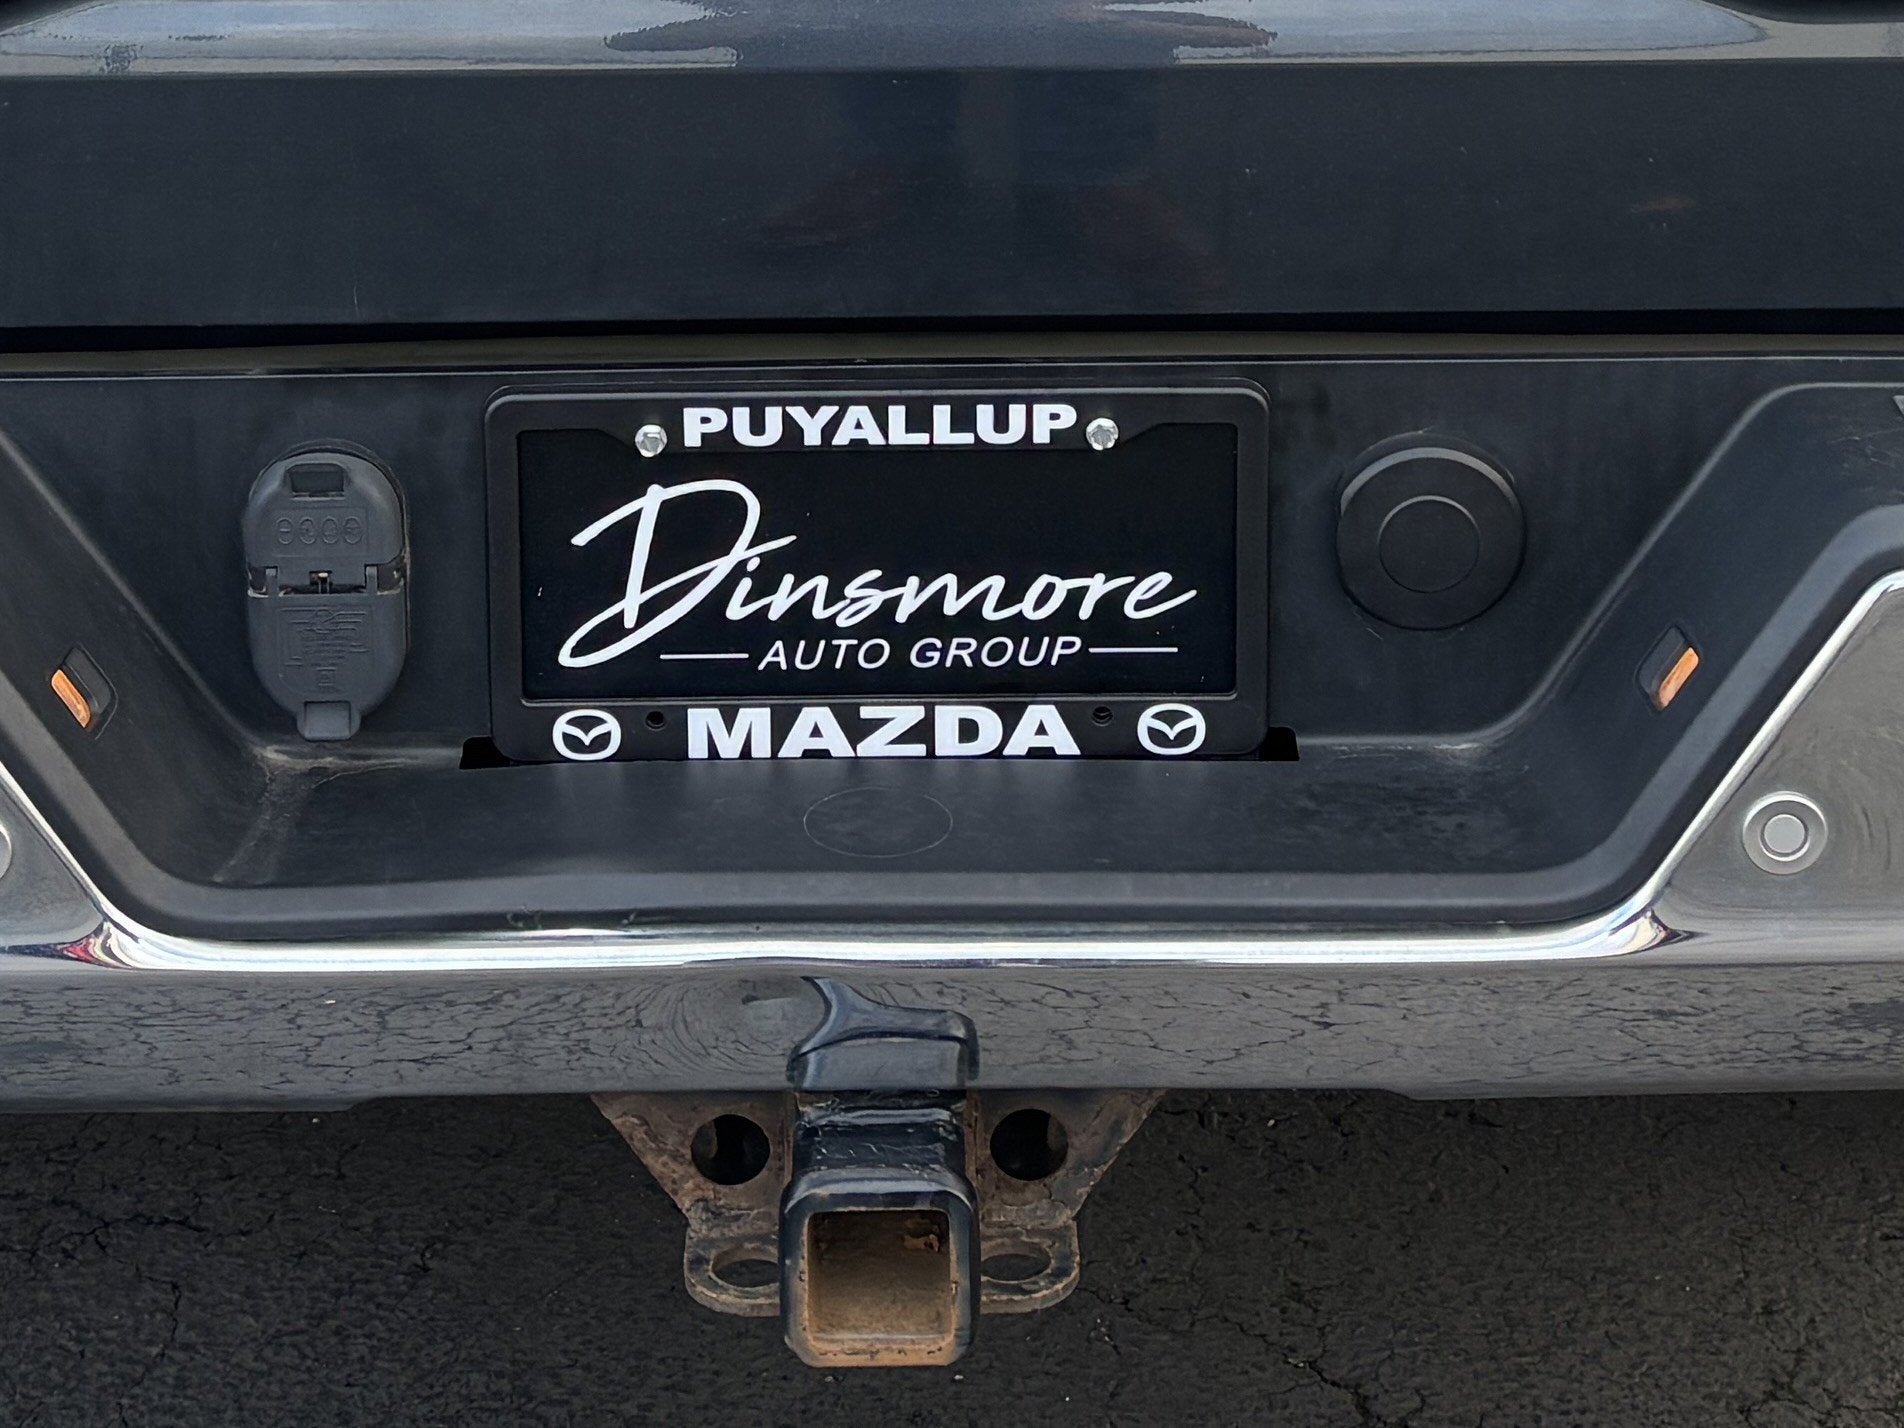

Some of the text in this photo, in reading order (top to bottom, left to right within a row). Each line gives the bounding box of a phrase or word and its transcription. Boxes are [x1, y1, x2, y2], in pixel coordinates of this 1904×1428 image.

[682, 403, 1078, 448] PUYALLUP
[558, 478, 1198, 668] Dinsmore
[758, 635, 1083, 671] AUTO GROUP
[684, 703, 1082, 760] MAZDA
